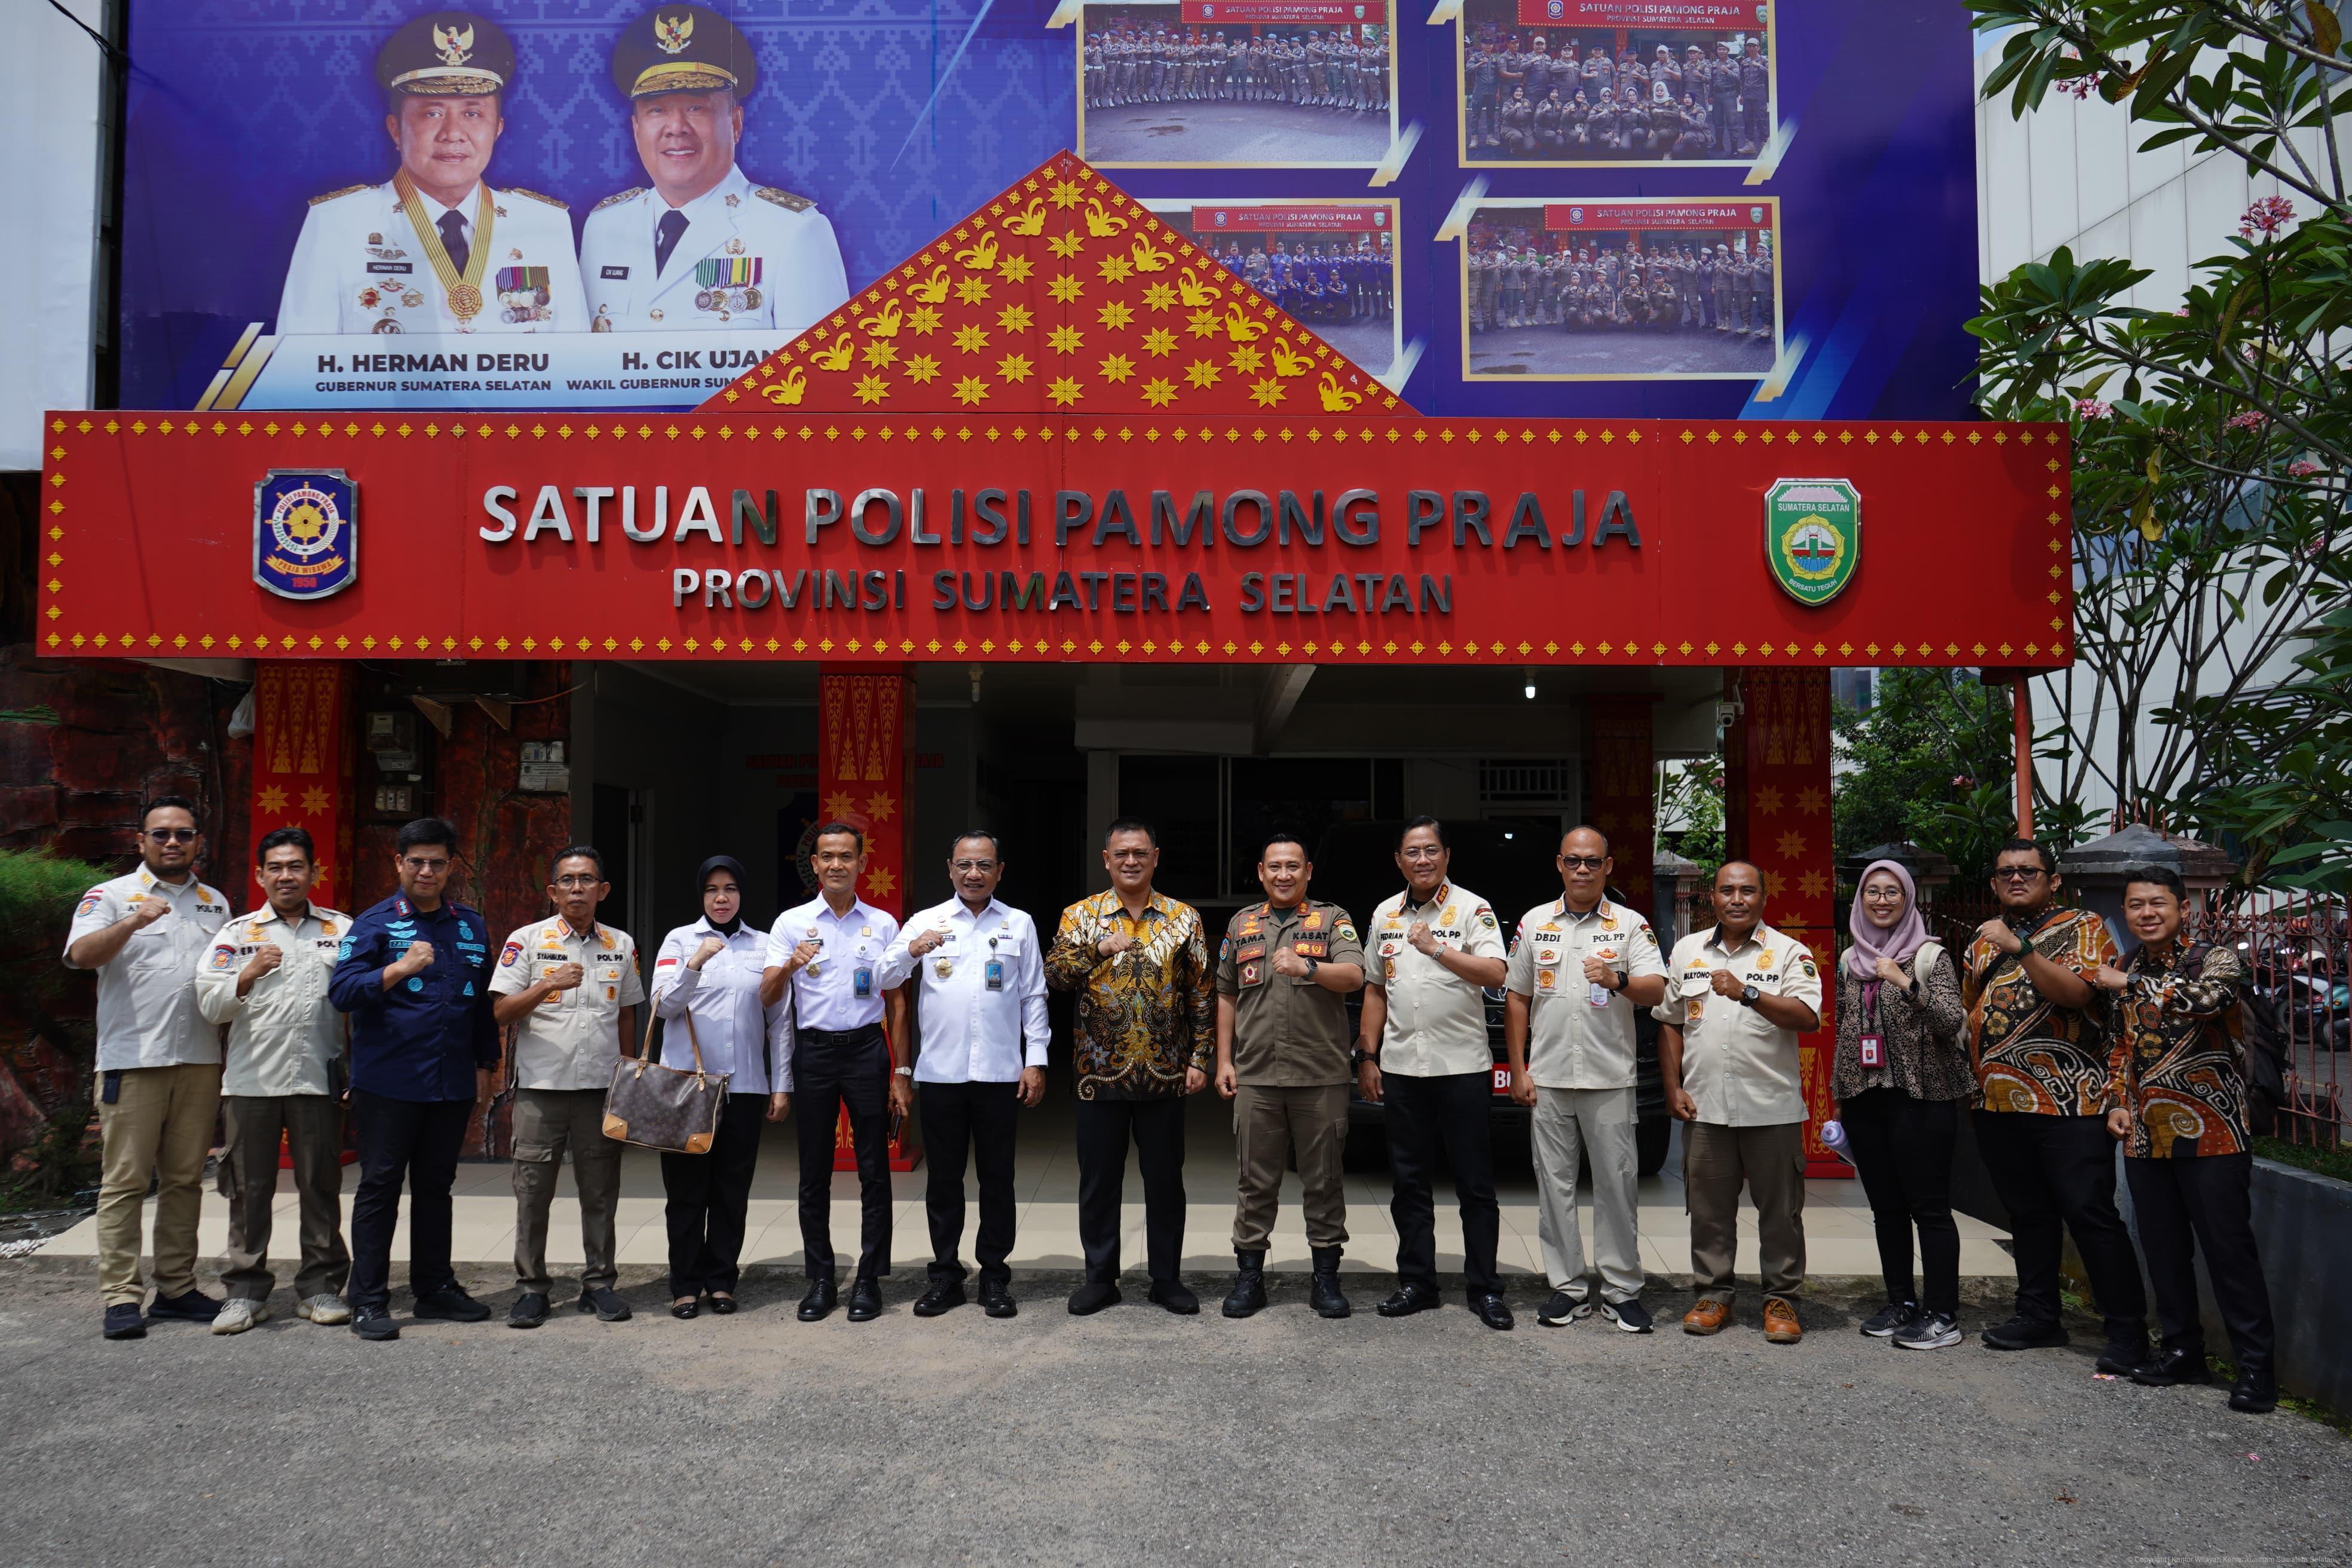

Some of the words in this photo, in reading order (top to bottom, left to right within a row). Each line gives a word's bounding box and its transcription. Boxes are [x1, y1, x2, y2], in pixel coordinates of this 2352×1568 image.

[1579, 3, 1622, 13] SATUAN
[1625, 4, 1657, 14] POLISI
[1659, 5, 1705, 14] PAMONG
[1707, 5, 1740, 15] PRAJA
[1597, 209, 1634, 218] SATUAN
[1707, 209, 1737, 217] PRAJA
[318, 355, 344, 372] H.
[353, 354, 468, 372] HERMAN
[476, 354, 549, 372] DERU
[622, 352, 649, 370] H.
[656, 351, 702, 369] CIK
[316, 381, 397, 392] GUBERNUR
[401, 381, 483, 391] SUMATERA
[486, 380, 552, 391] SELATAN
[566, 379, 616, 390] WAKIL
[620, 378, 700, 390] GUBERNUR
[277, 494, 293, 514] POLISI
[1778, 503, 1816, 512] SUMATERA
[1818, 504, 1849, 512] SELATAN
[479, 485, 777, 545] SATUAN
[806, 488, 1030, 545] POLISI
[1055, 488, 1379, 546] PAMONG
[1407, 489, 1642, 548] PRAJA
[673, 568, 904, 610] PROVINSI
[933, 568, 1211, 611] SUMATERA
[1240, 571, 1452, 613] SELATAN
[1788, 578, 1816, 592] BERSATU
[1817, 579, 1838, 591] TEGUH
[1236, 933, 1266, 947] TAMA
[1449, 930, 1460, 939] PP
[1766, 974, 1779, 982] PP
